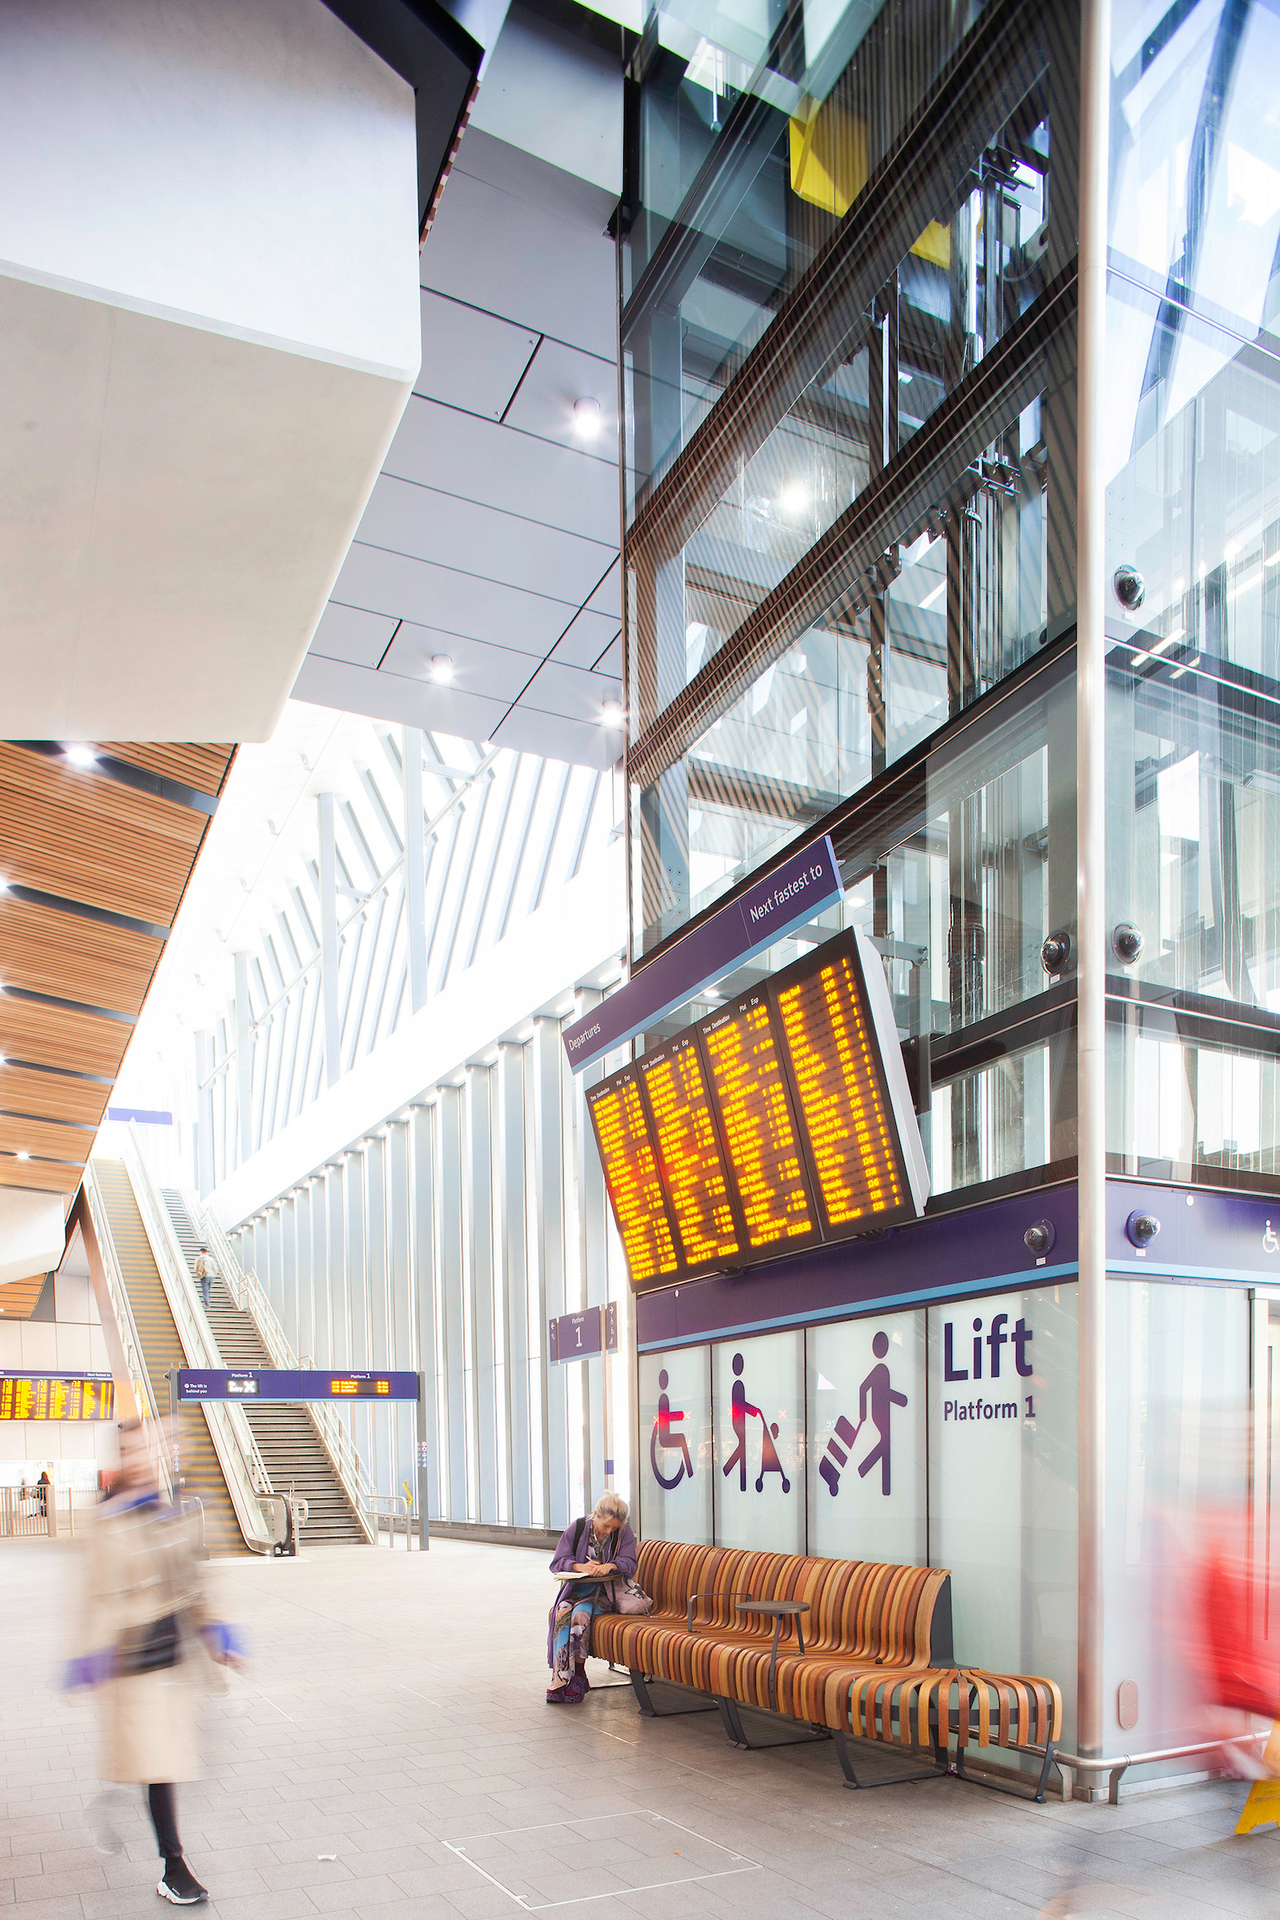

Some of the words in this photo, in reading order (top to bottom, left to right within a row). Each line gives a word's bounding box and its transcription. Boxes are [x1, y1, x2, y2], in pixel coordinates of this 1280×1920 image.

[749, 898, 774, 923] Next
[774, 872, 809, 906] fastest
[809, 864, 823, 881] to
[702, 1026, 711, 1034] Time
[711, 1014, 730, 1029] Destination
[750, 997, 759, 1005] Exp
[568, 1023, 601, 1051] Departures
[681, 1039, 689, 1047] Exp
[572, 1316, 584, 1324] Platform
[575, 1326, 582, 1347] 1
[944, 1313, 1033, 1382] Lift
[944, 1398, 1017, 1421] Platform
[1025, 1395, 1036, 1418] 1
